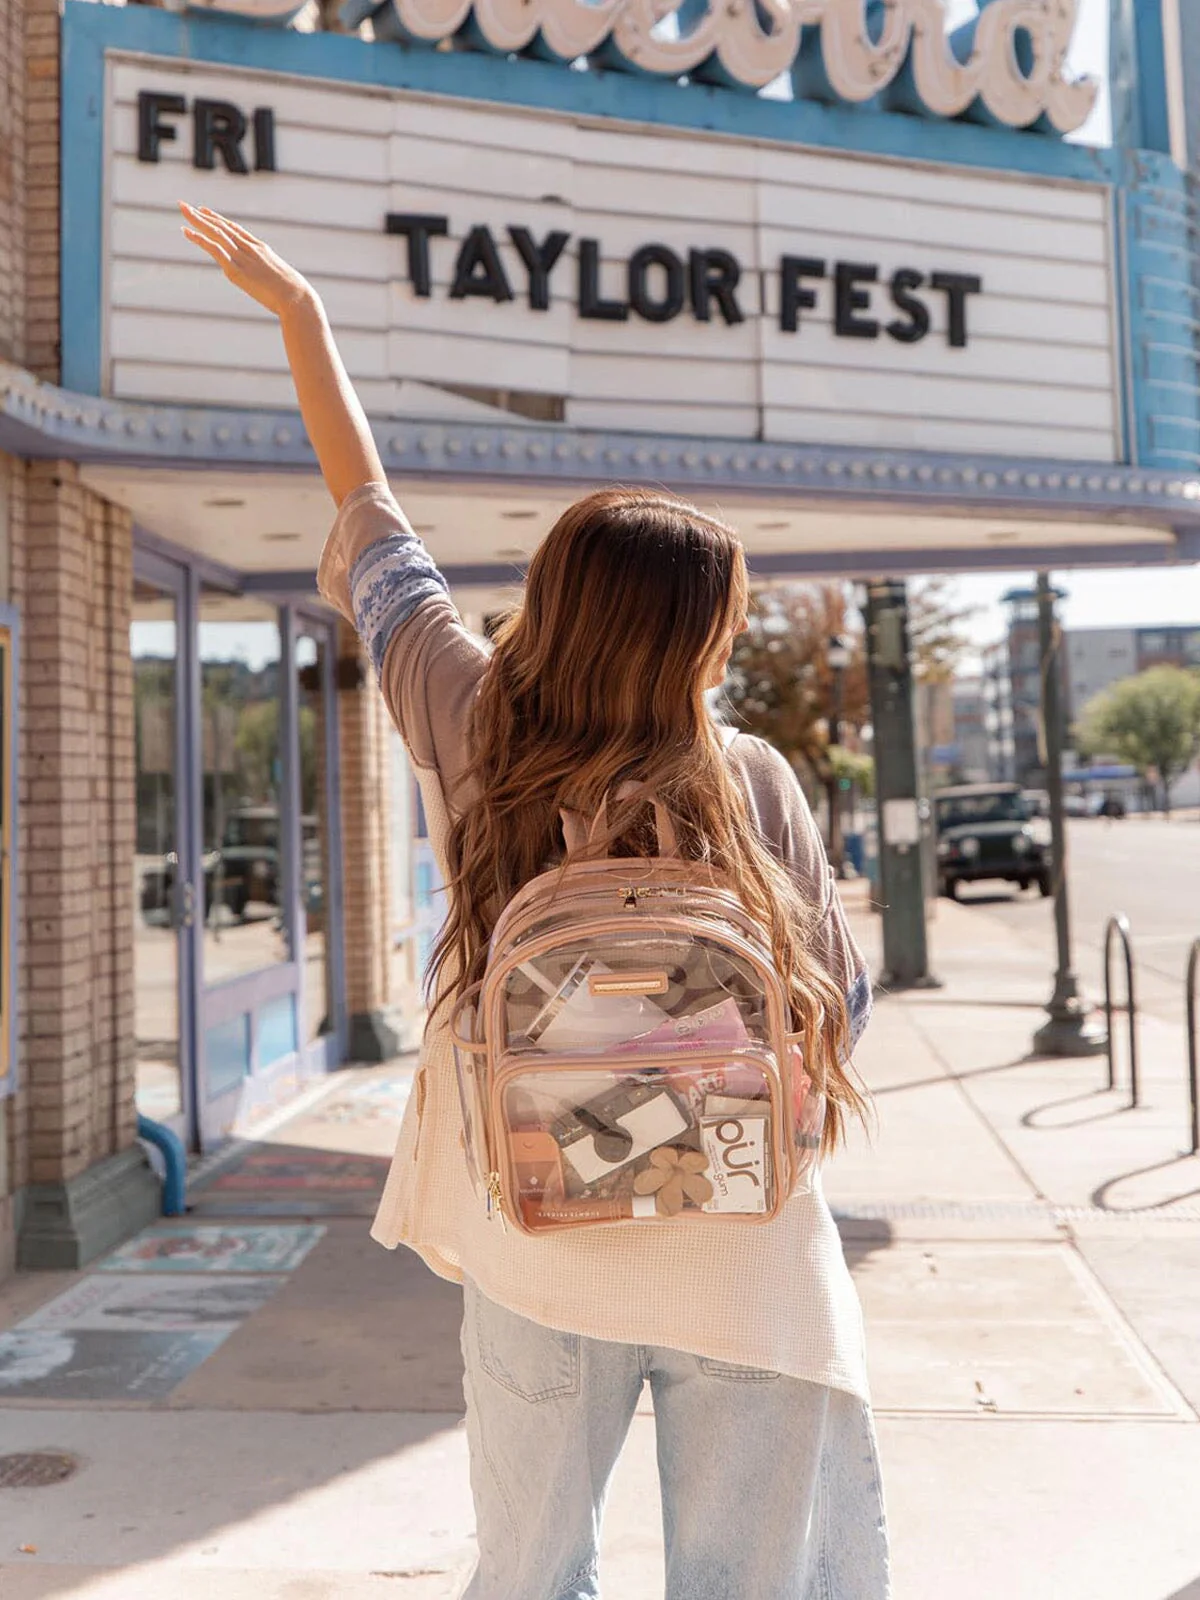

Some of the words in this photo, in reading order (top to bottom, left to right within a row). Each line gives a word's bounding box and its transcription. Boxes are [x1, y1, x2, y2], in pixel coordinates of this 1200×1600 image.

[136, 91, 277, 175] FRI
[384, 212, 745, 327] TAYLOR
[778, 255, 982, 348] FEST
[713, 1173, 729, 1197] gum
